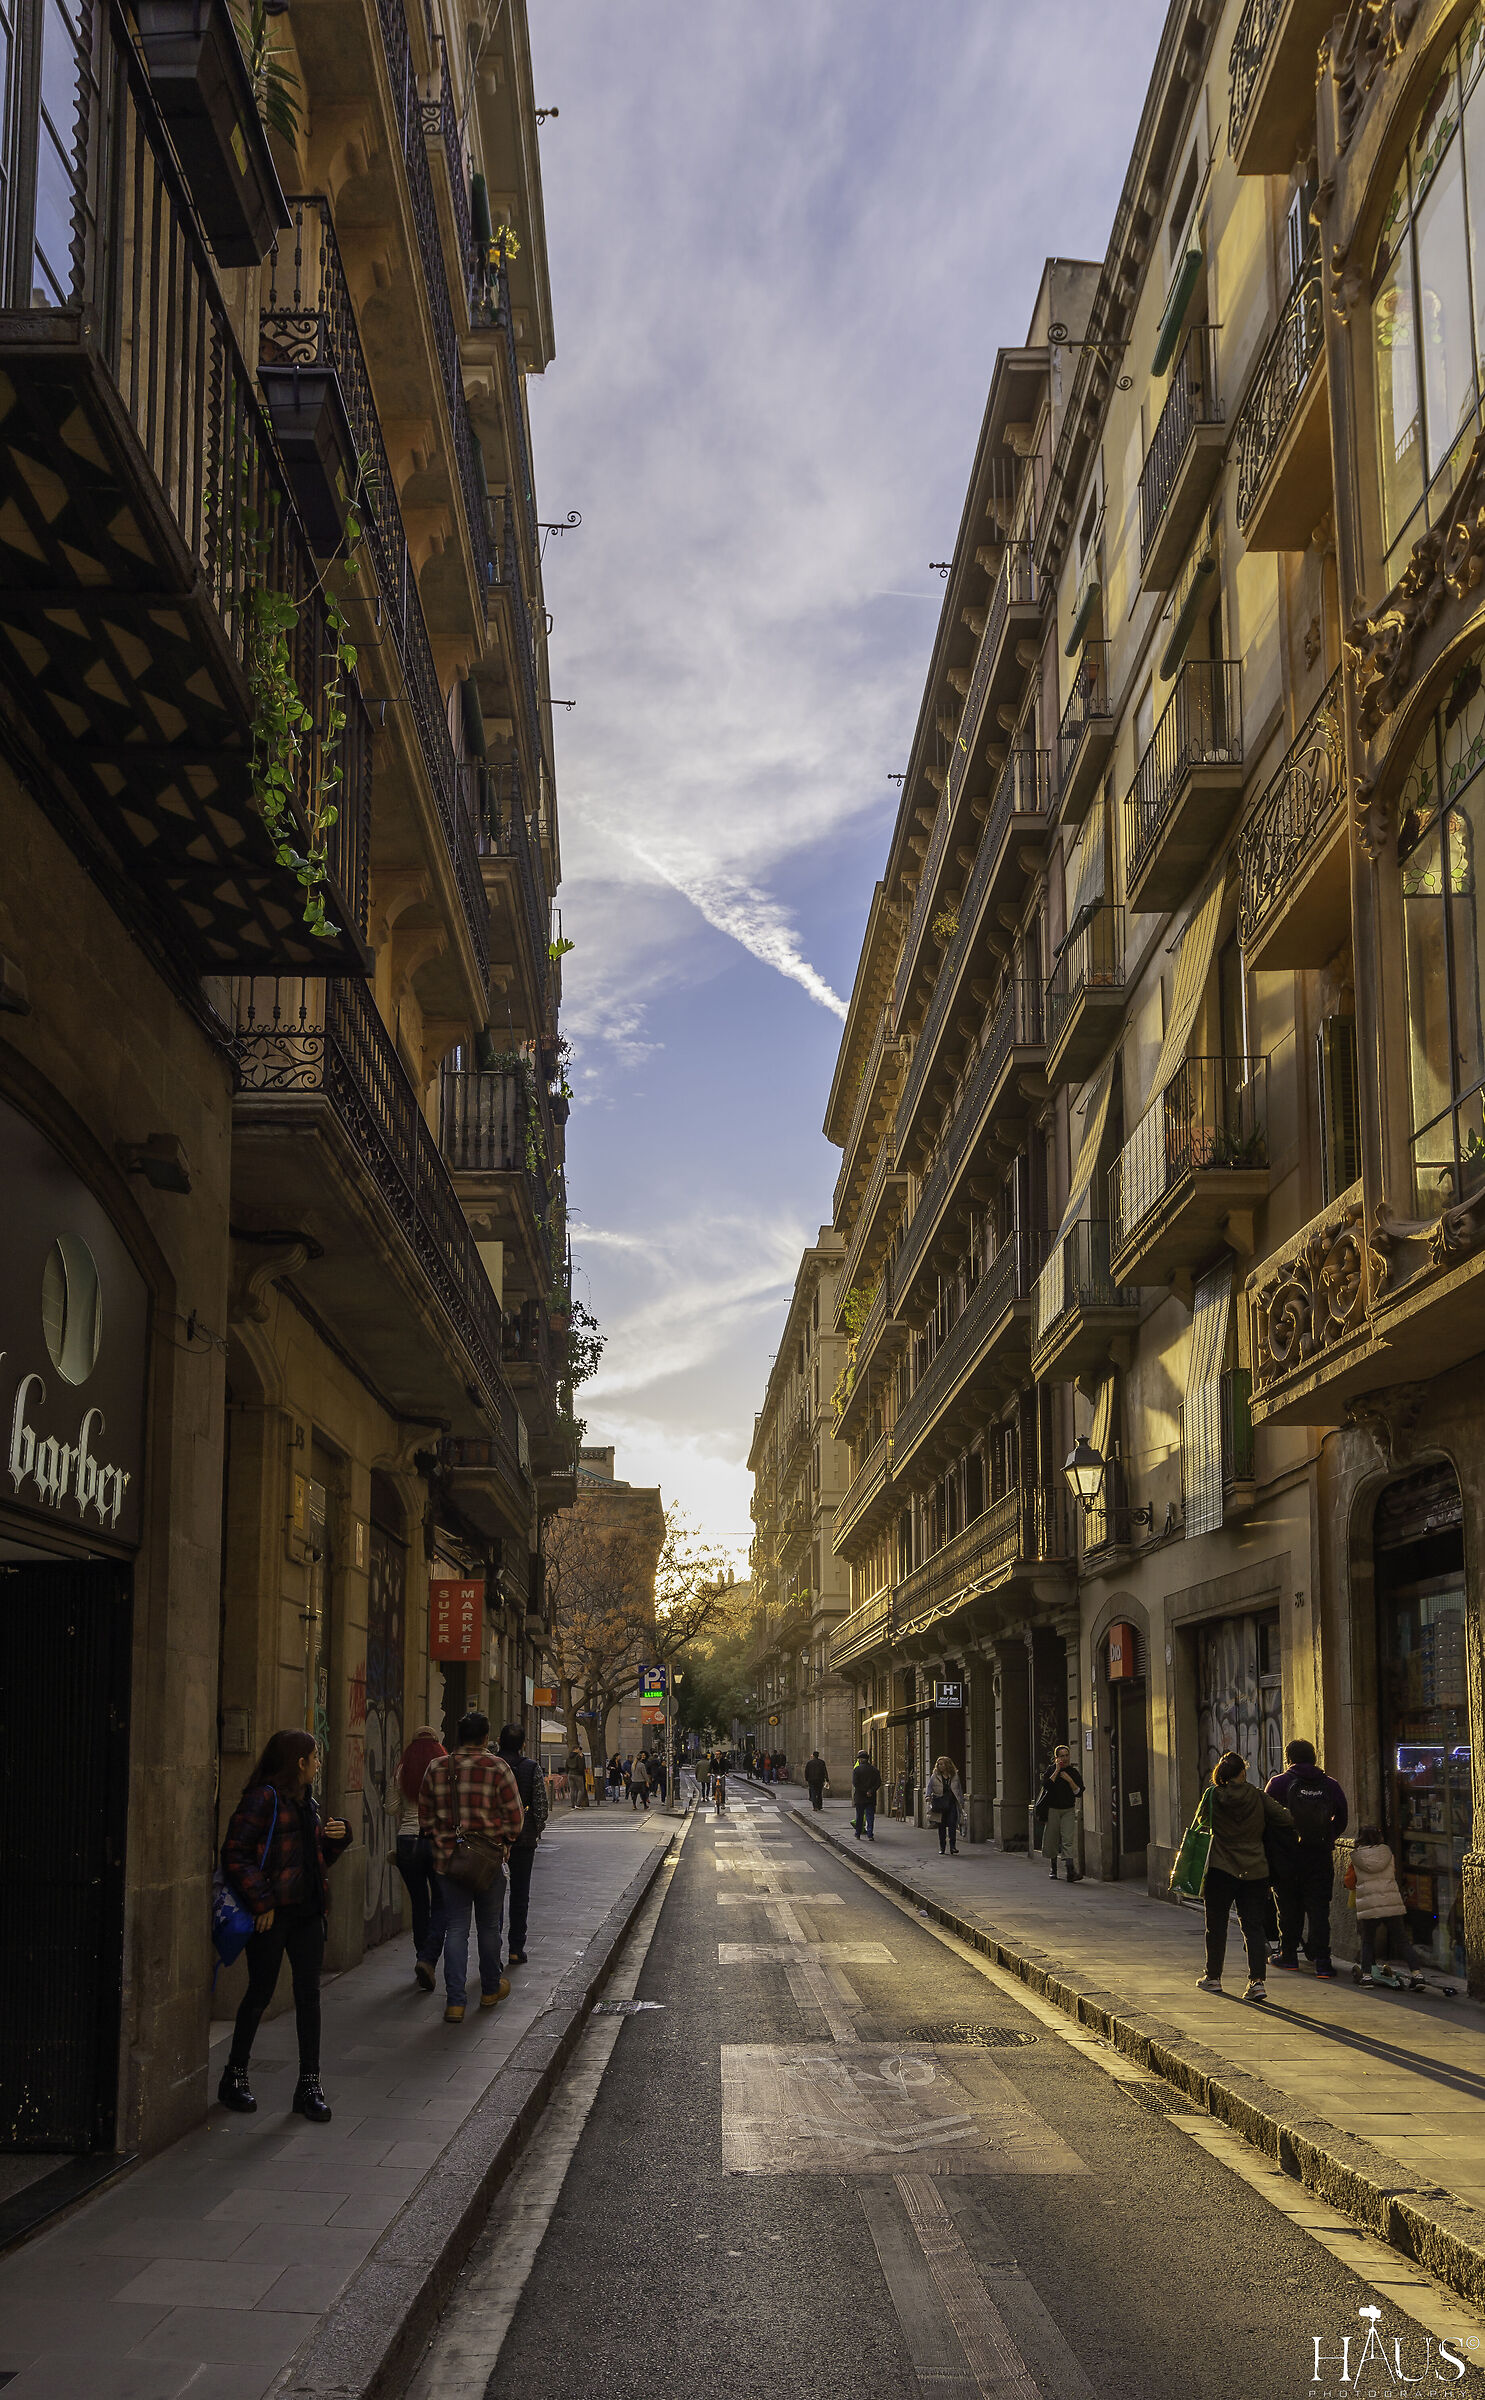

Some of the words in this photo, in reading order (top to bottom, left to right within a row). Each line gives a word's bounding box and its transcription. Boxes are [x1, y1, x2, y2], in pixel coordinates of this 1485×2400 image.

[8, 1373, 133, 1529] barber
[438, 1590, 450, 1643] SUPER
[461, 1590, 474, 1654] MARKET
[644, 1668, 660, 1689] P
[943, 1684, 954, 1696] H
